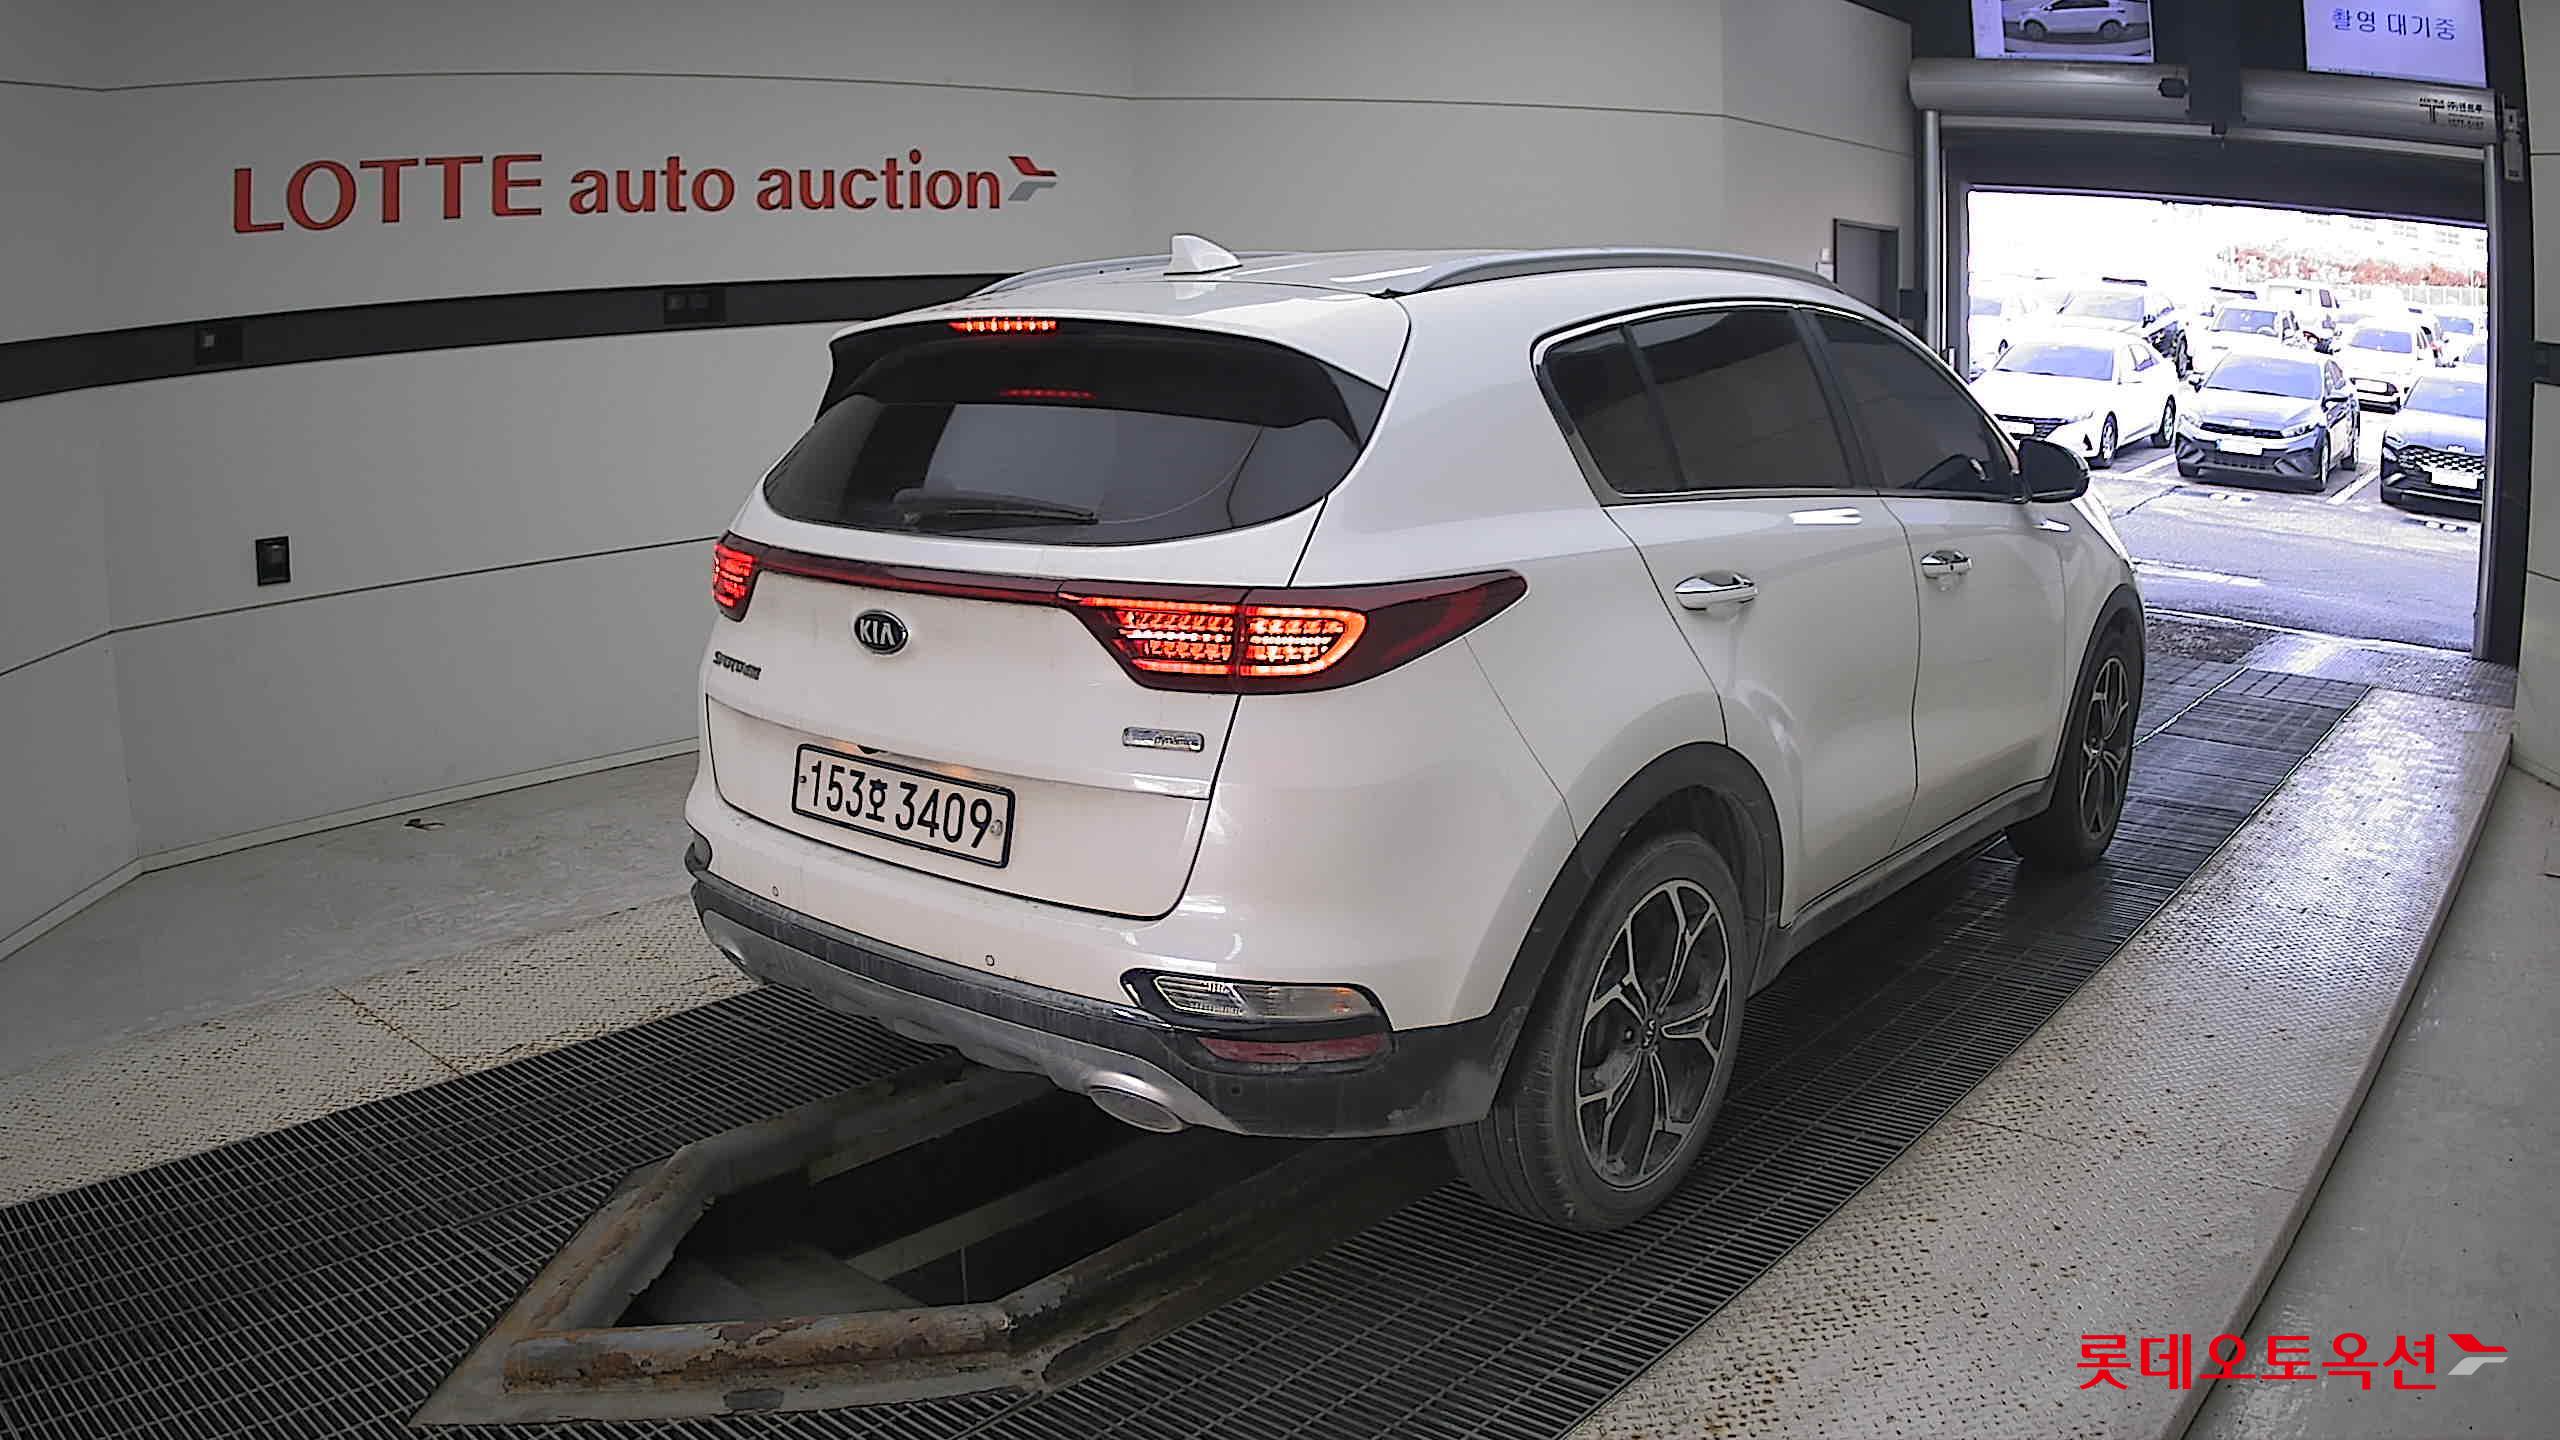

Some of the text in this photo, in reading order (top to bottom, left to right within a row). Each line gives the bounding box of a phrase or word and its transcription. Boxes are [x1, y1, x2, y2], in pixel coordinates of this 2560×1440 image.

[233, 149, 1002, 234] LOTTE auto auction
[860, 619, 896, 646] KIA
[811, 760, 993, 849] 153호 3409
